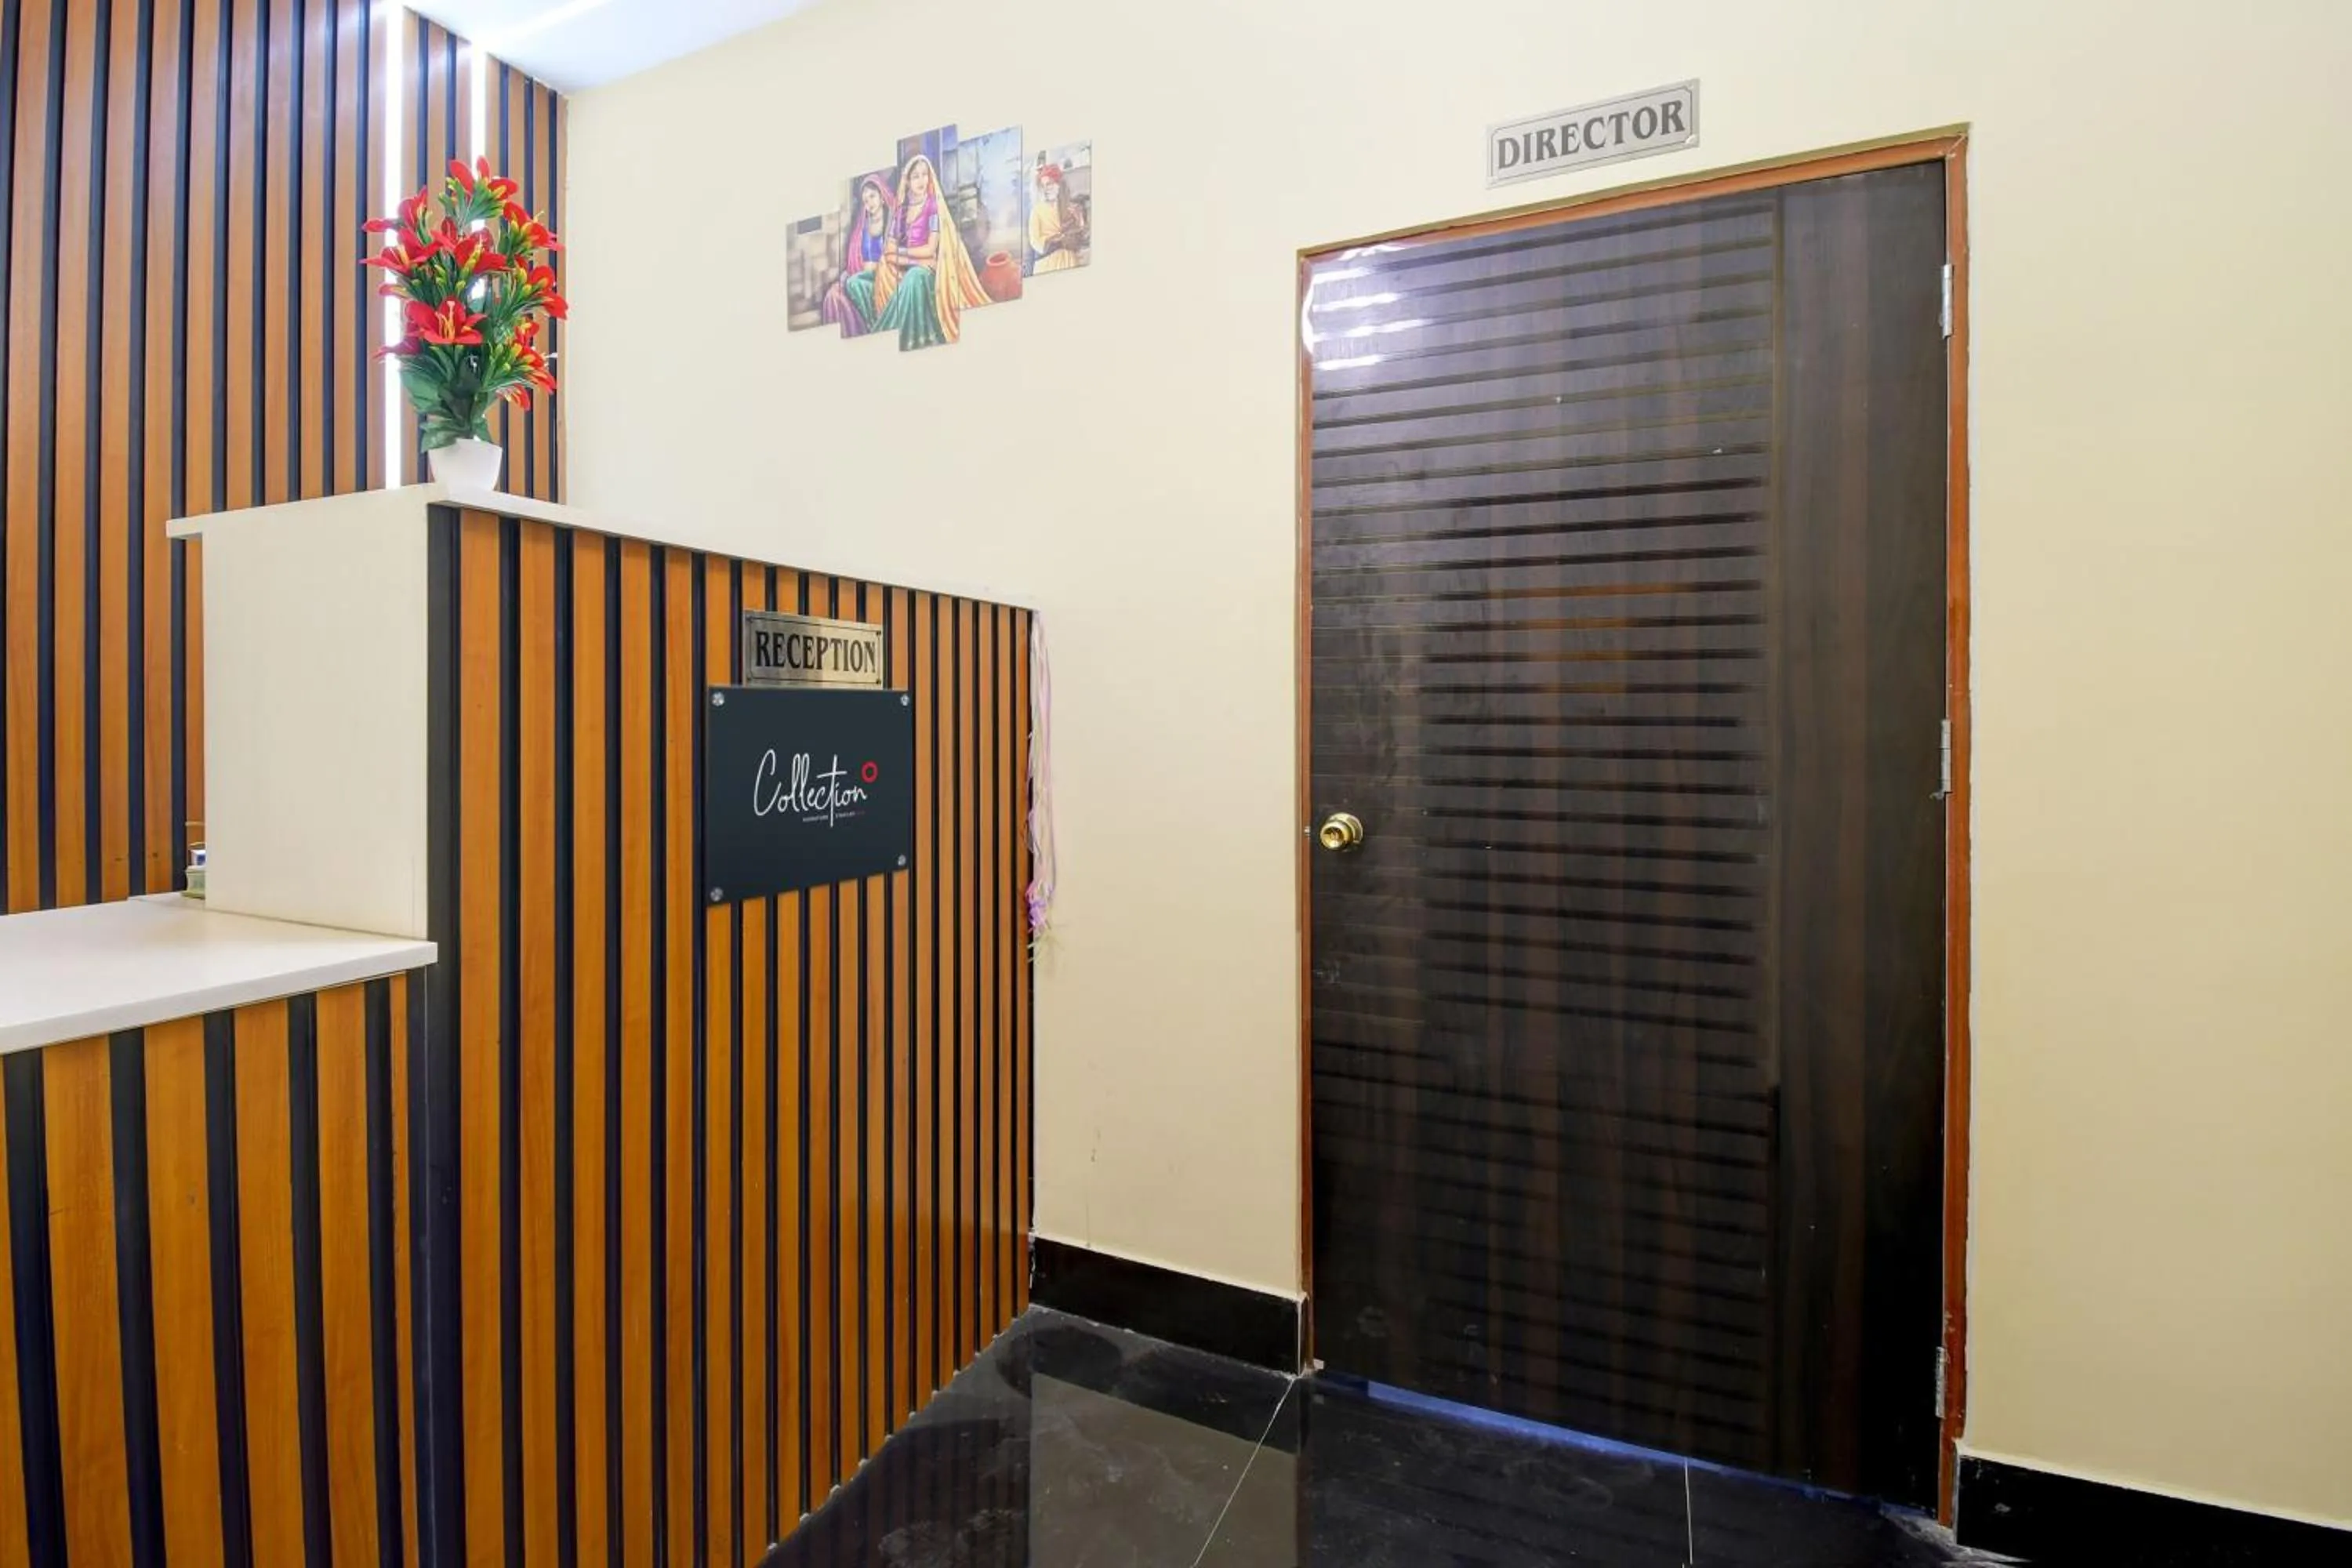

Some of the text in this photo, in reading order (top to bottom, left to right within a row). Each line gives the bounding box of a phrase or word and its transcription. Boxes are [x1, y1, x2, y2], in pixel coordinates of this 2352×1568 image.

[1497, 100, 1686, 169] DIRECTOR
[755, 630, 877, 673] RECEPTION
[753, 749, 867, 827] Collection
